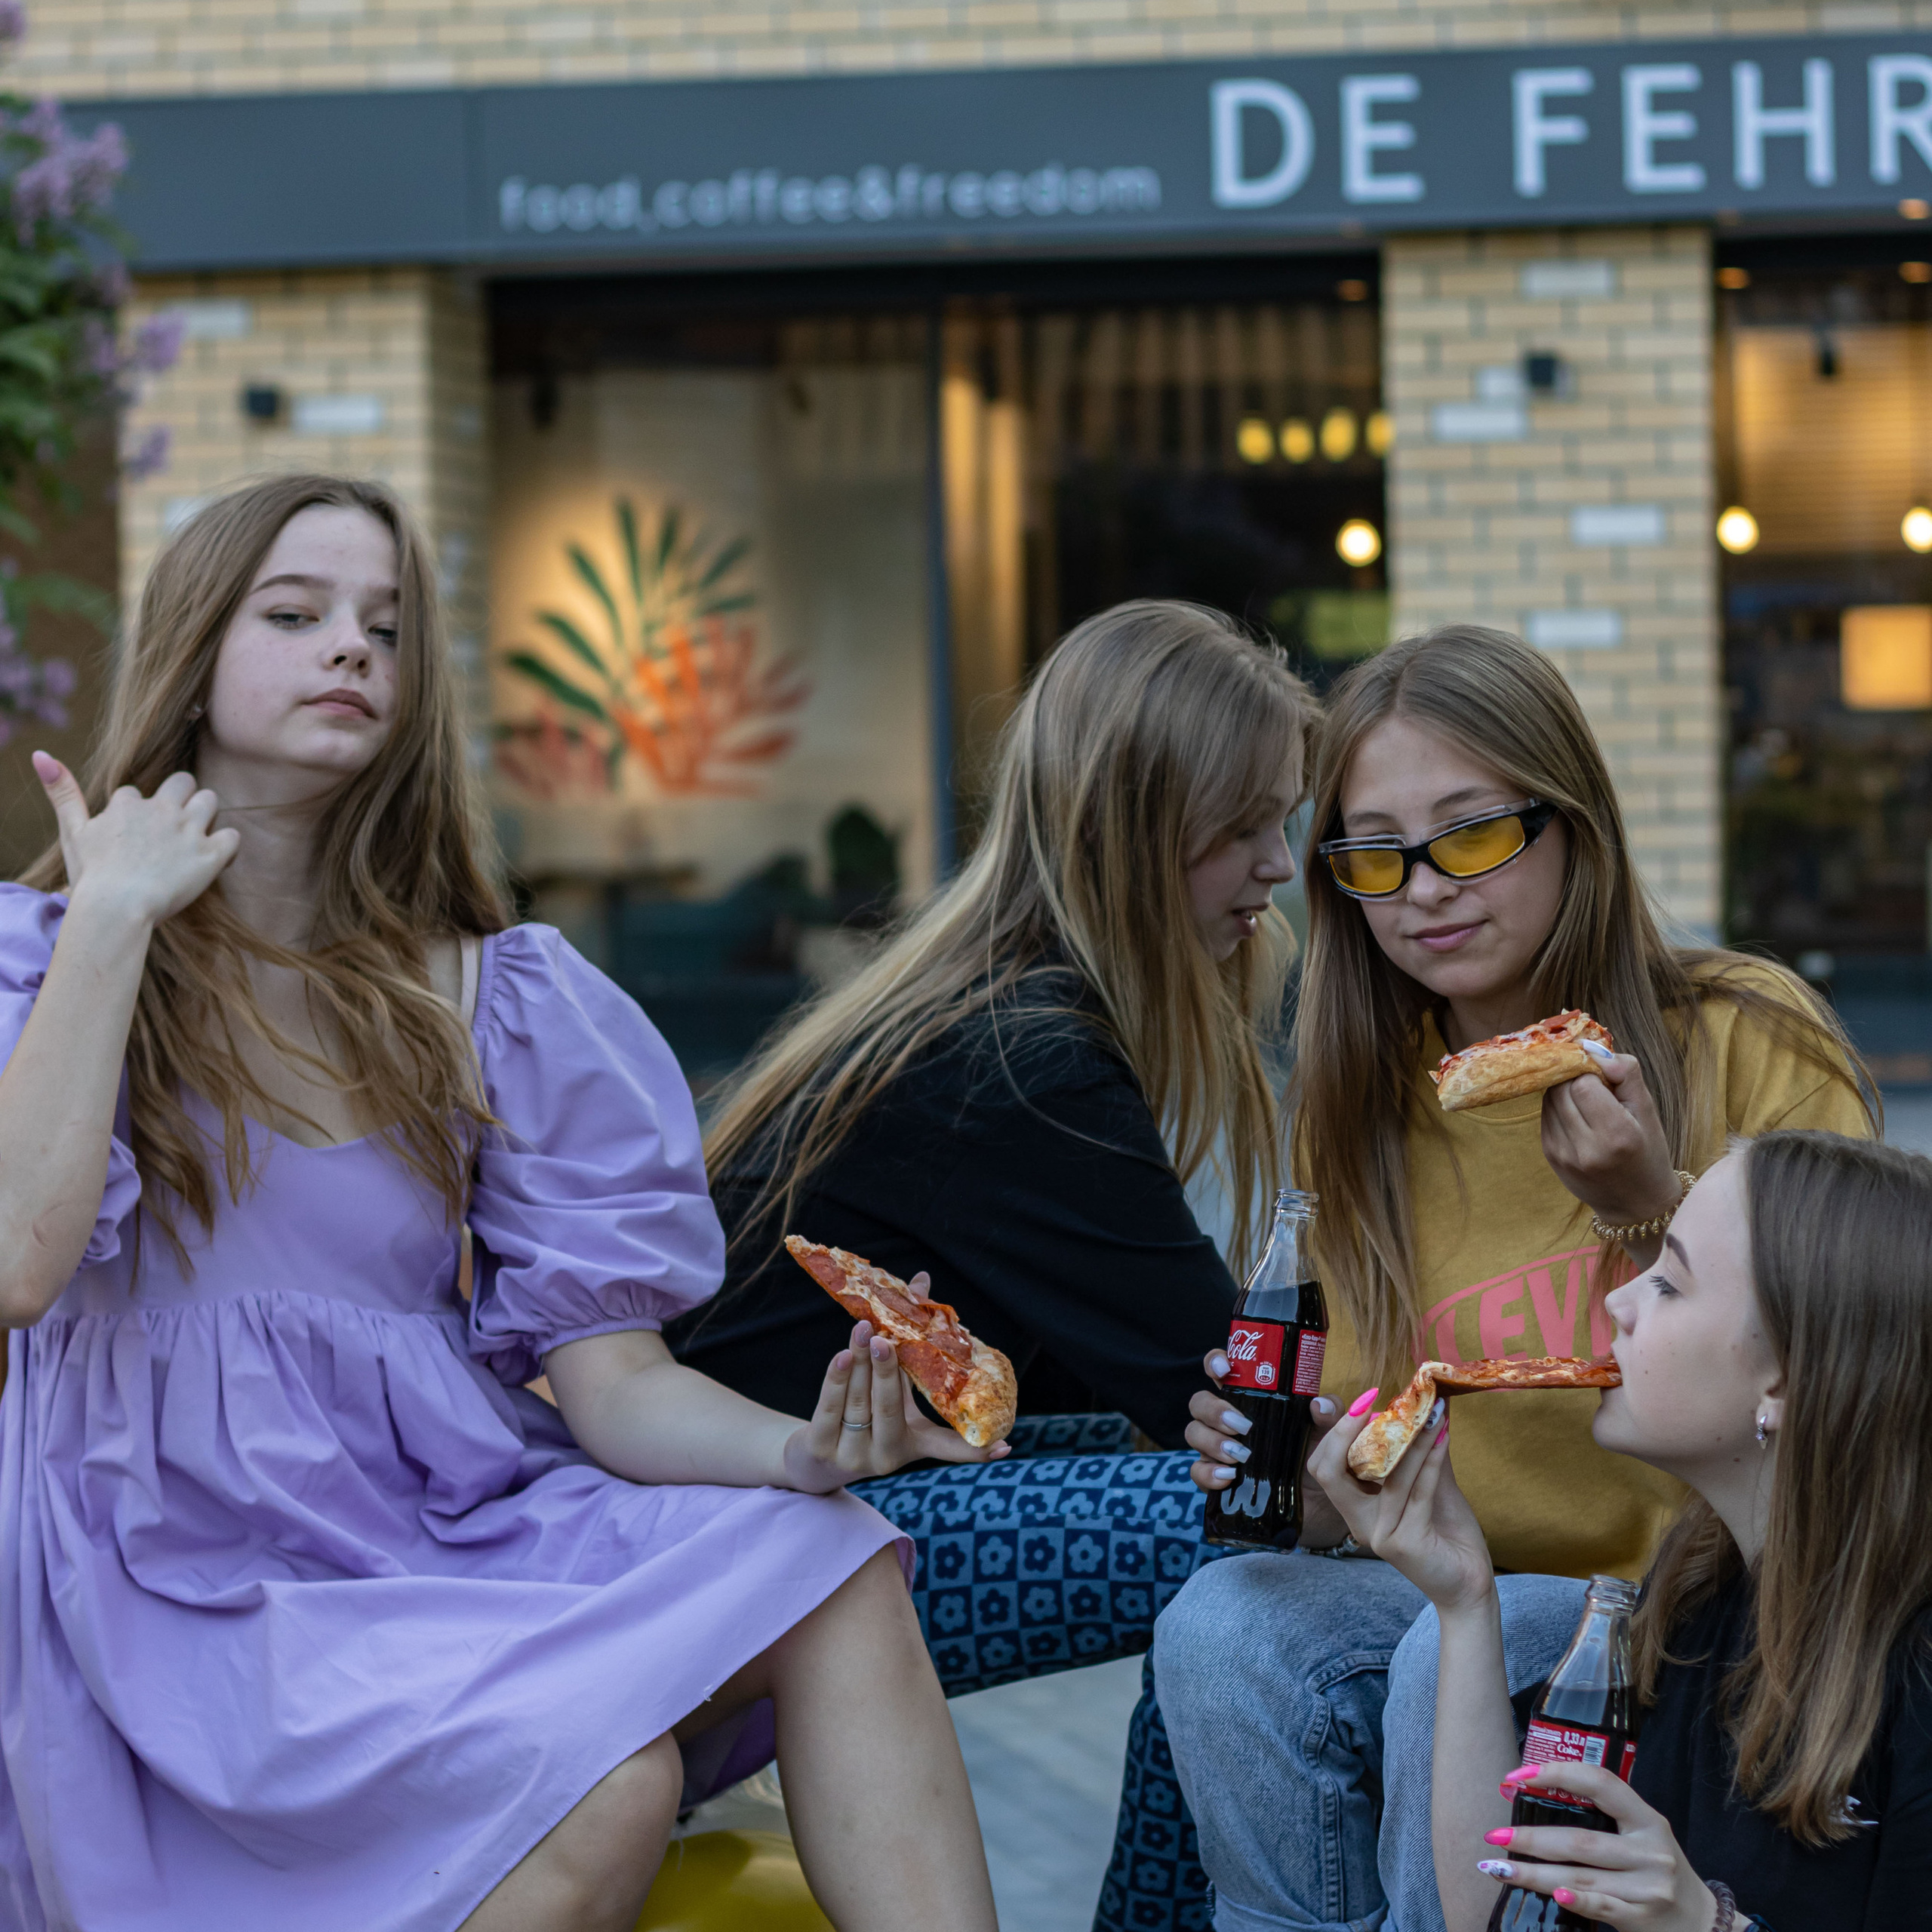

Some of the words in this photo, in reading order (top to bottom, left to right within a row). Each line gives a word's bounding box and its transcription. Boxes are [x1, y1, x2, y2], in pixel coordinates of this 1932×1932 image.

[1211, 73, 1424, 208] DE
[1512, 54, 1932, 198] FEHR
[1564, 1730, 1580, 1745] 0,33
[1557, 1743, 1580, 1756] Coke
